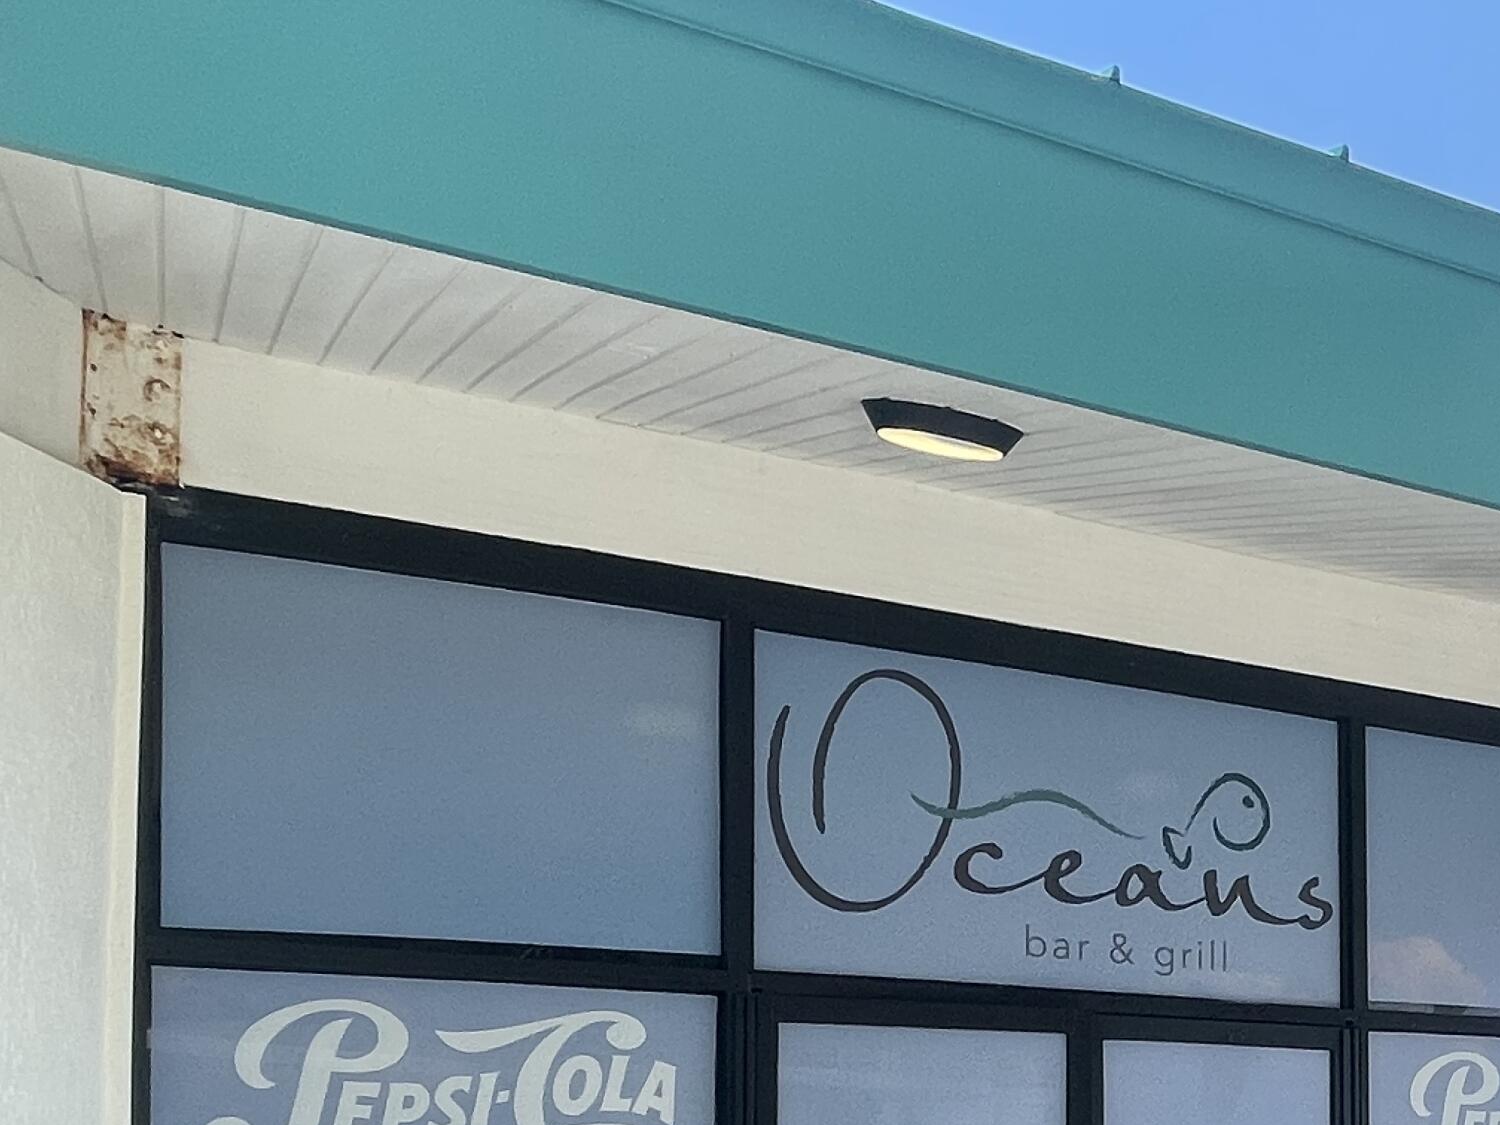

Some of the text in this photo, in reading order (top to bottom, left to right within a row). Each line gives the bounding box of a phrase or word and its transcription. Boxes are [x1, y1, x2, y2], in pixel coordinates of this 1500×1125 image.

[767, 668, 1333, 929] Oceans
[1024, 923, 1229, 977] bar & grill
